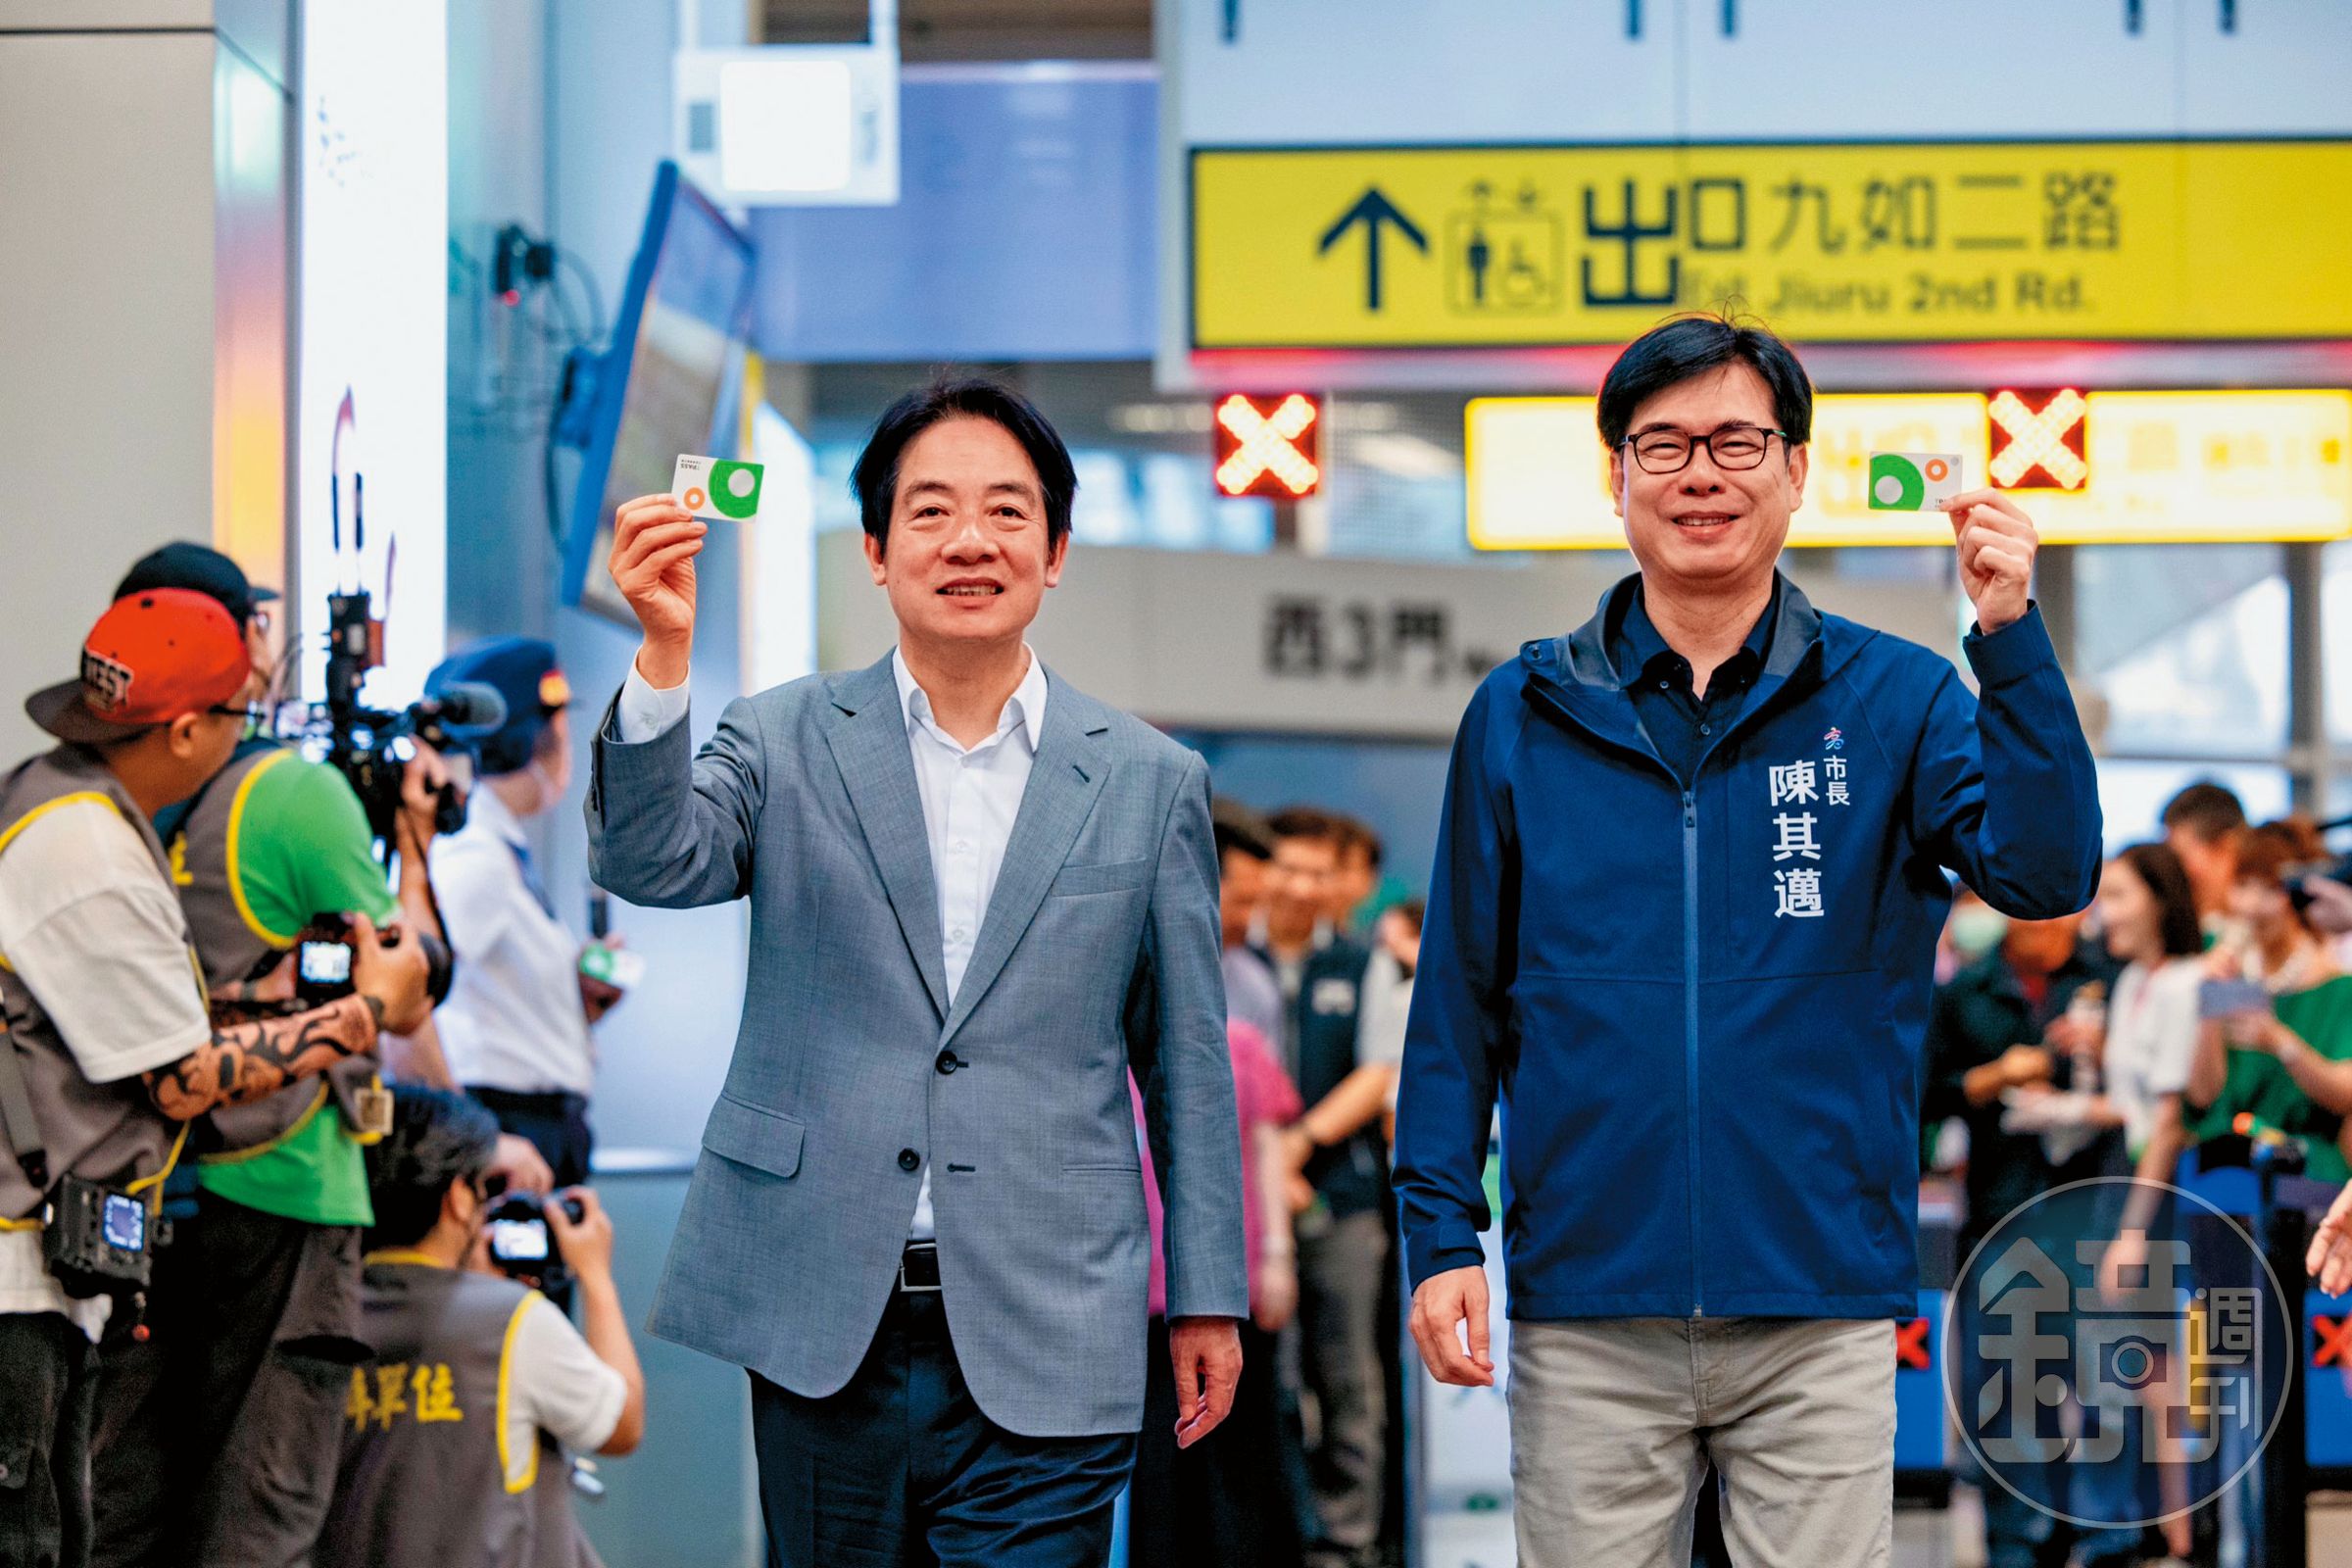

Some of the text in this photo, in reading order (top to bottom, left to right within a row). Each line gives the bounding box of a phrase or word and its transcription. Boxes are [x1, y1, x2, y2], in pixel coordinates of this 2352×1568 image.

[1823, 755, 1851, 807] 市長
[1768, 759, 1825, 919] 陳其邁
